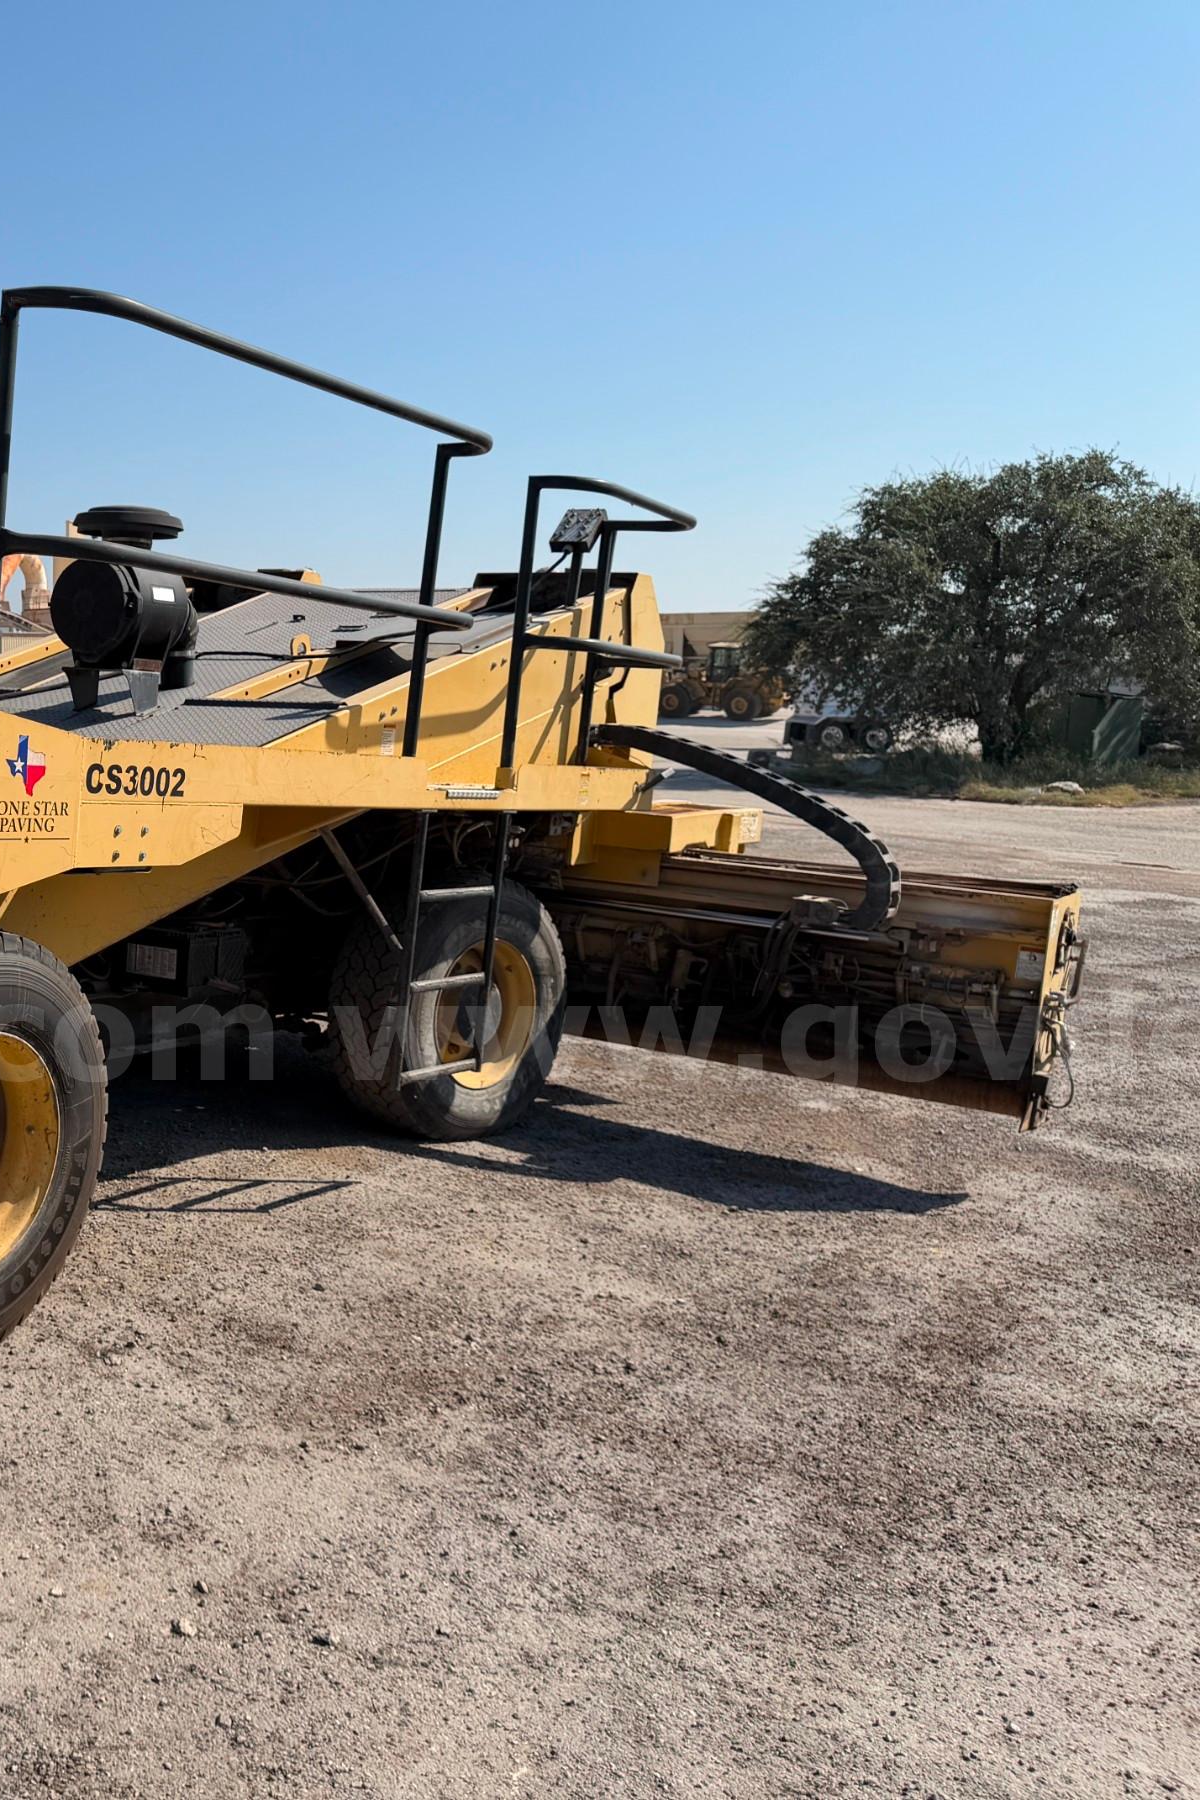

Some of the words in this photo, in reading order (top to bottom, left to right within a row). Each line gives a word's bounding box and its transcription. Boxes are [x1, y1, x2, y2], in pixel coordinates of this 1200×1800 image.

[85, 763, 186, 797] CS3002
[33, 801, 69, 816] STAR
[0, 817, 55, 833] PAVING
